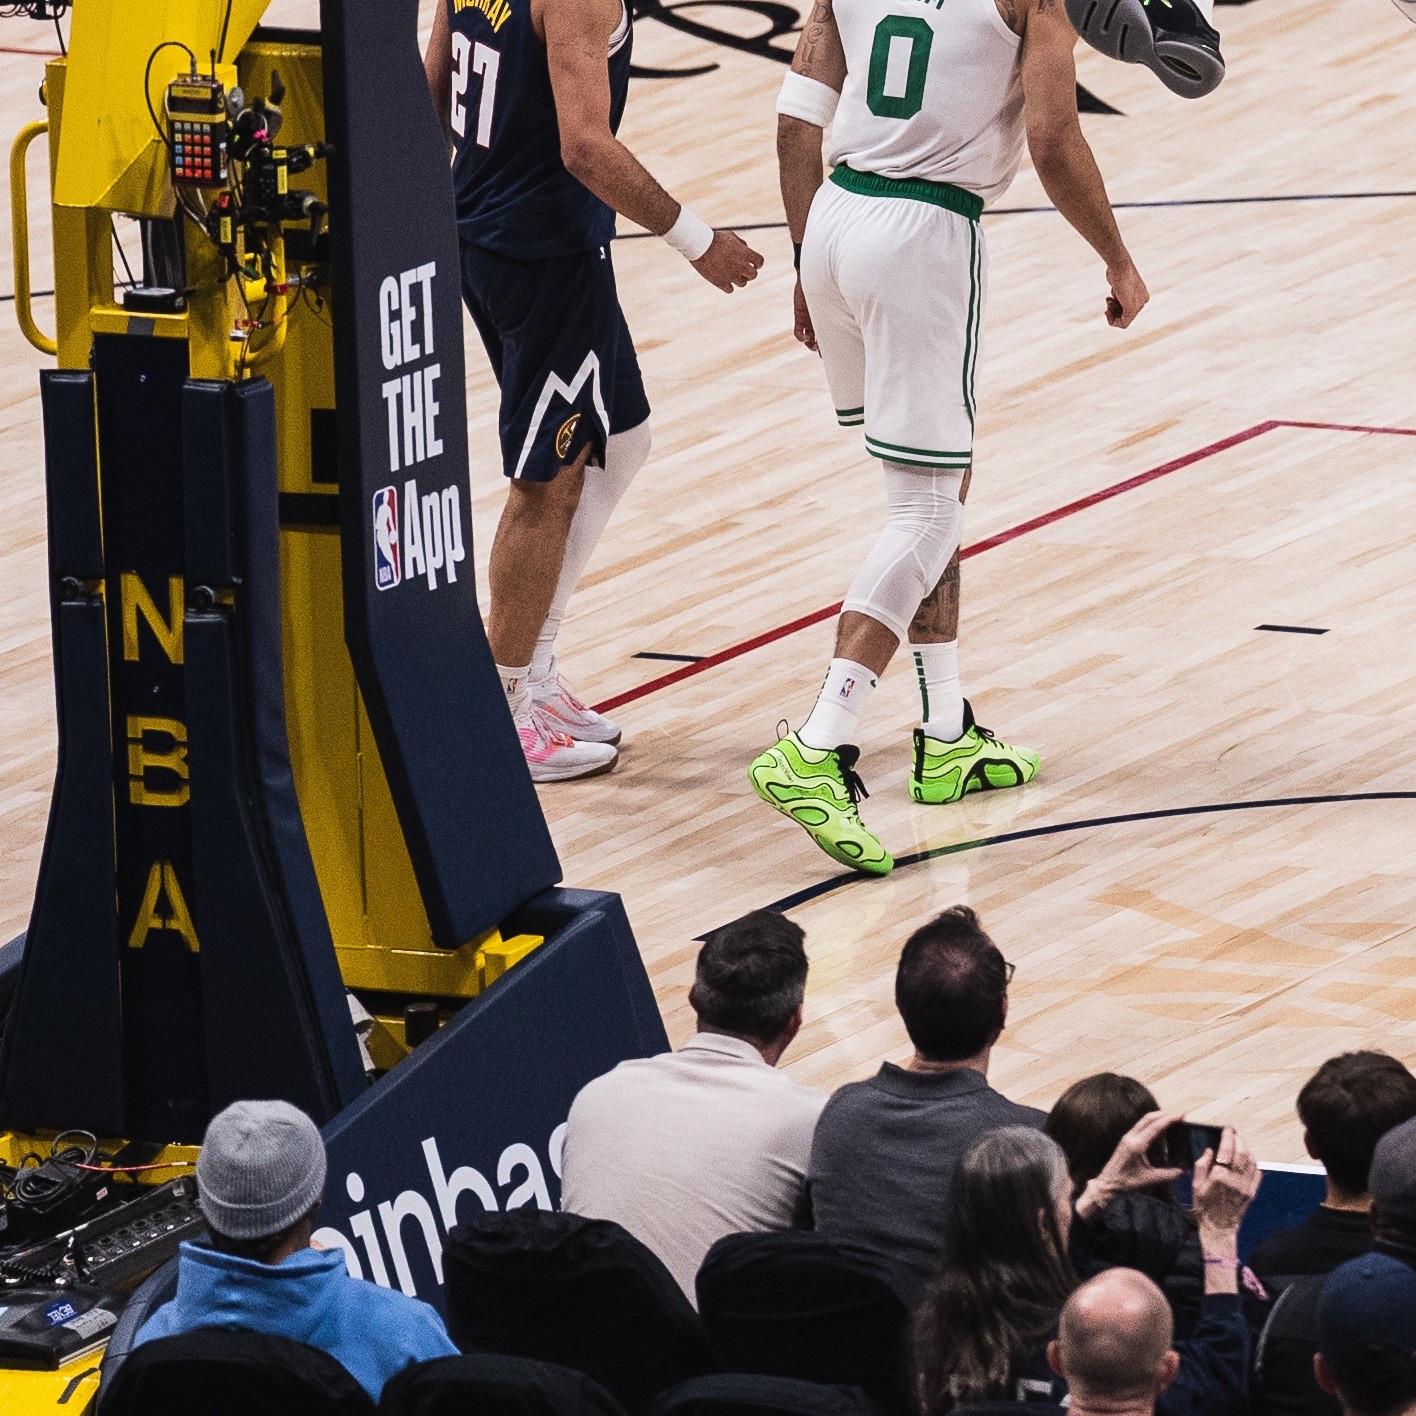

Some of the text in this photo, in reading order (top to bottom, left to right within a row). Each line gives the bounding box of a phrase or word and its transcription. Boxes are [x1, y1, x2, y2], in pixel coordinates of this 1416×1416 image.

[450, 30, 501, 149] 27
[866, 14, 935, 121] 0
[379, 261, 437, 370] GET
[381, 362, 444, 472] THE
[404, 478, 465, 591] App
